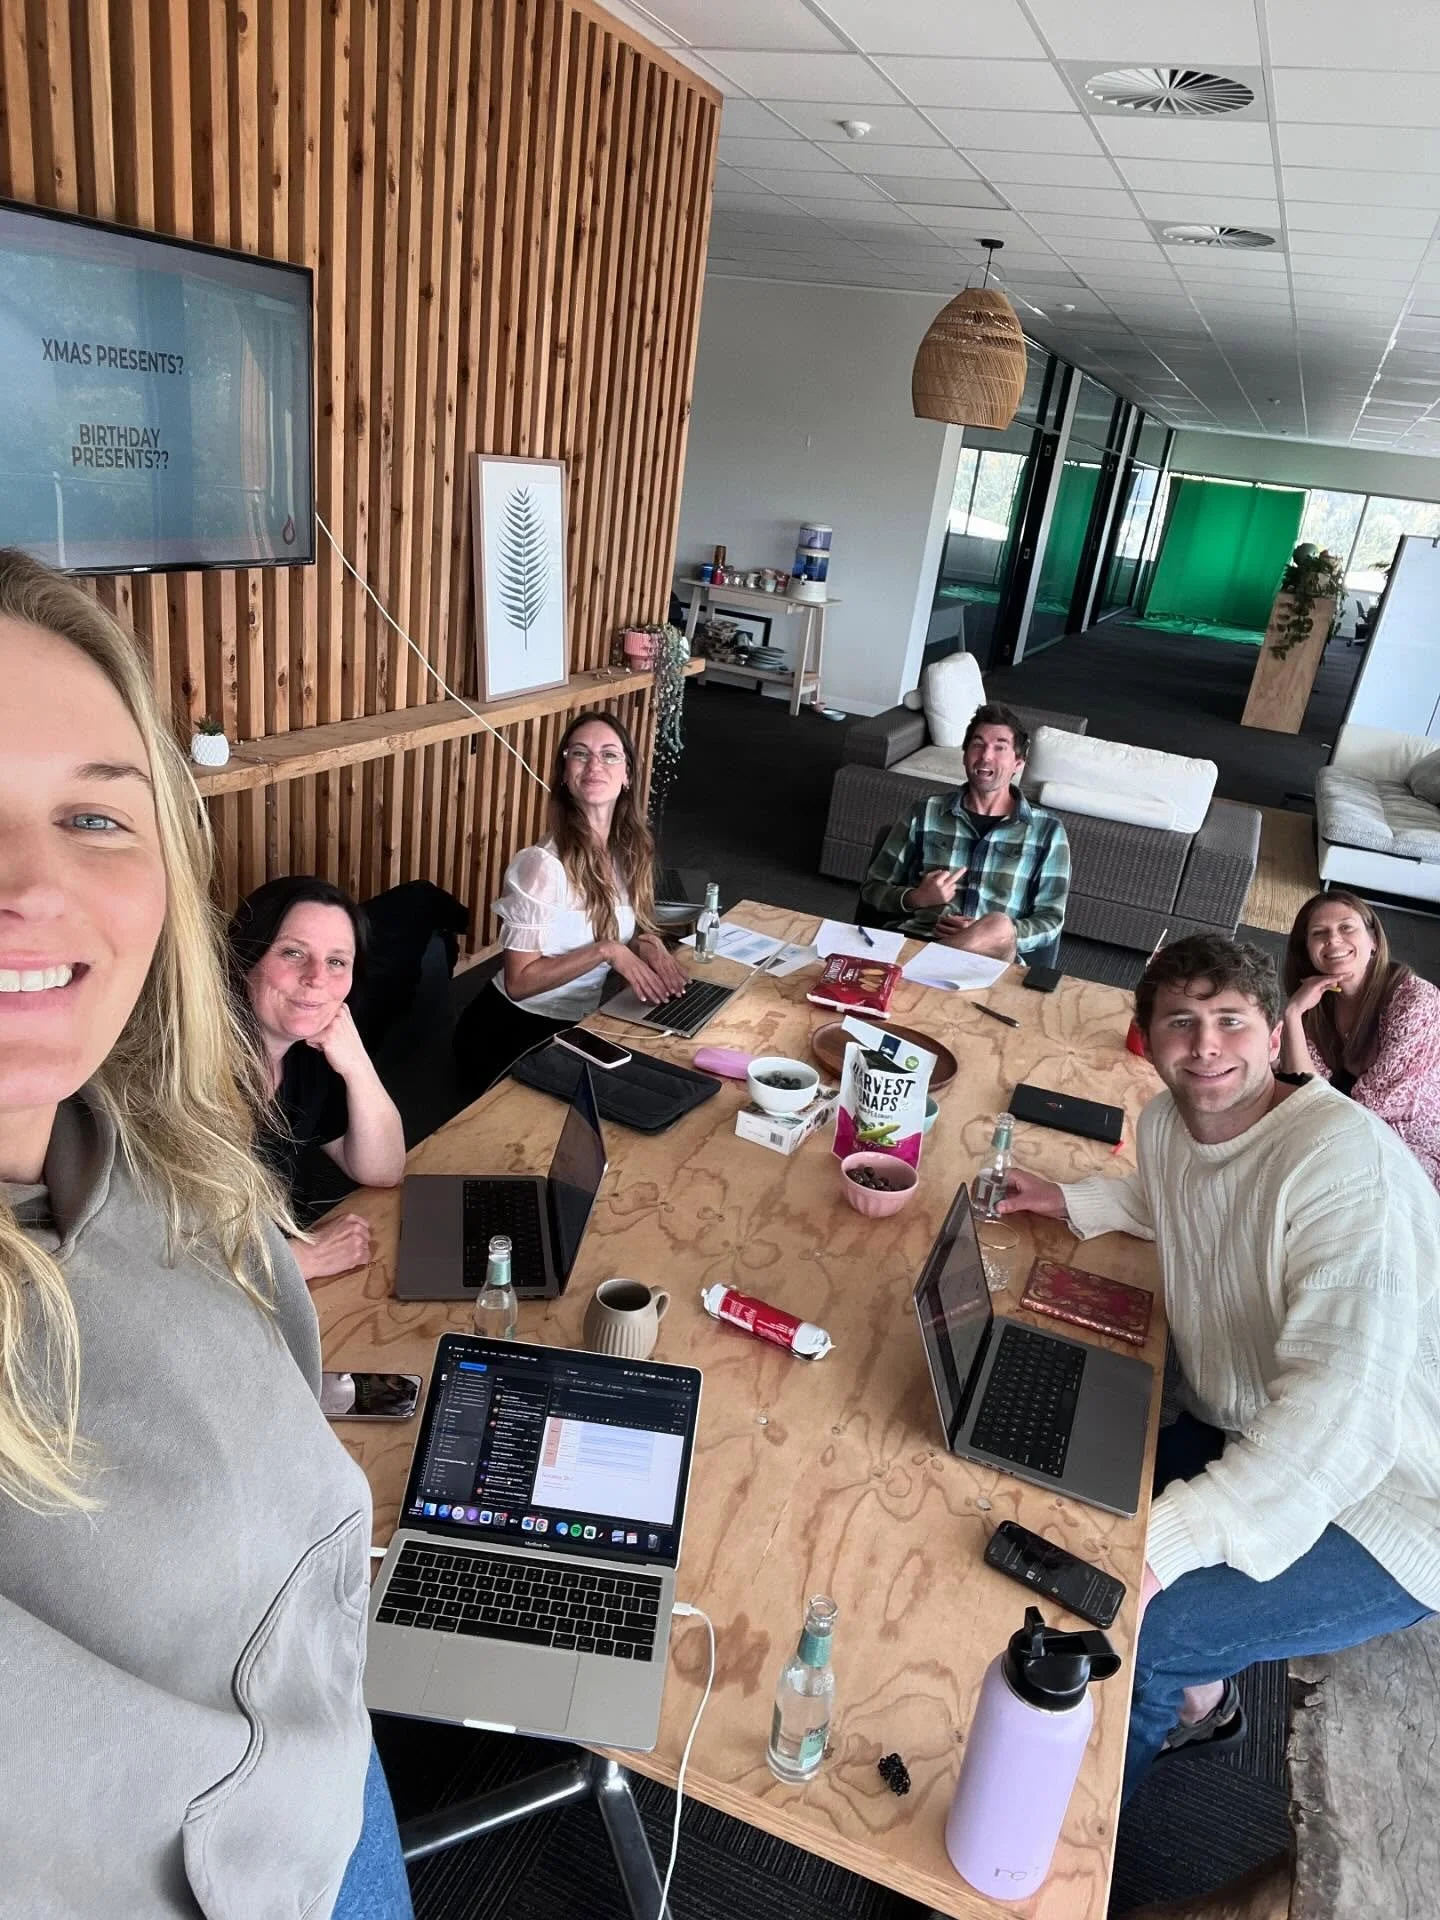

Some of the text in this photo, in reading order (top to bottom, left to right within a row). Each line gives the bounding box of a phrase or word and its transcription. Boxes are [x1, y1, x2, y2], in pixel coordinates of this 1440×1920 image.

[41, 337, 184, 375] XMAS PRESENTS?
[79, 423, 160, 449] BIRTHDAY
[71, 446, 169, 470] PRESENTS??
